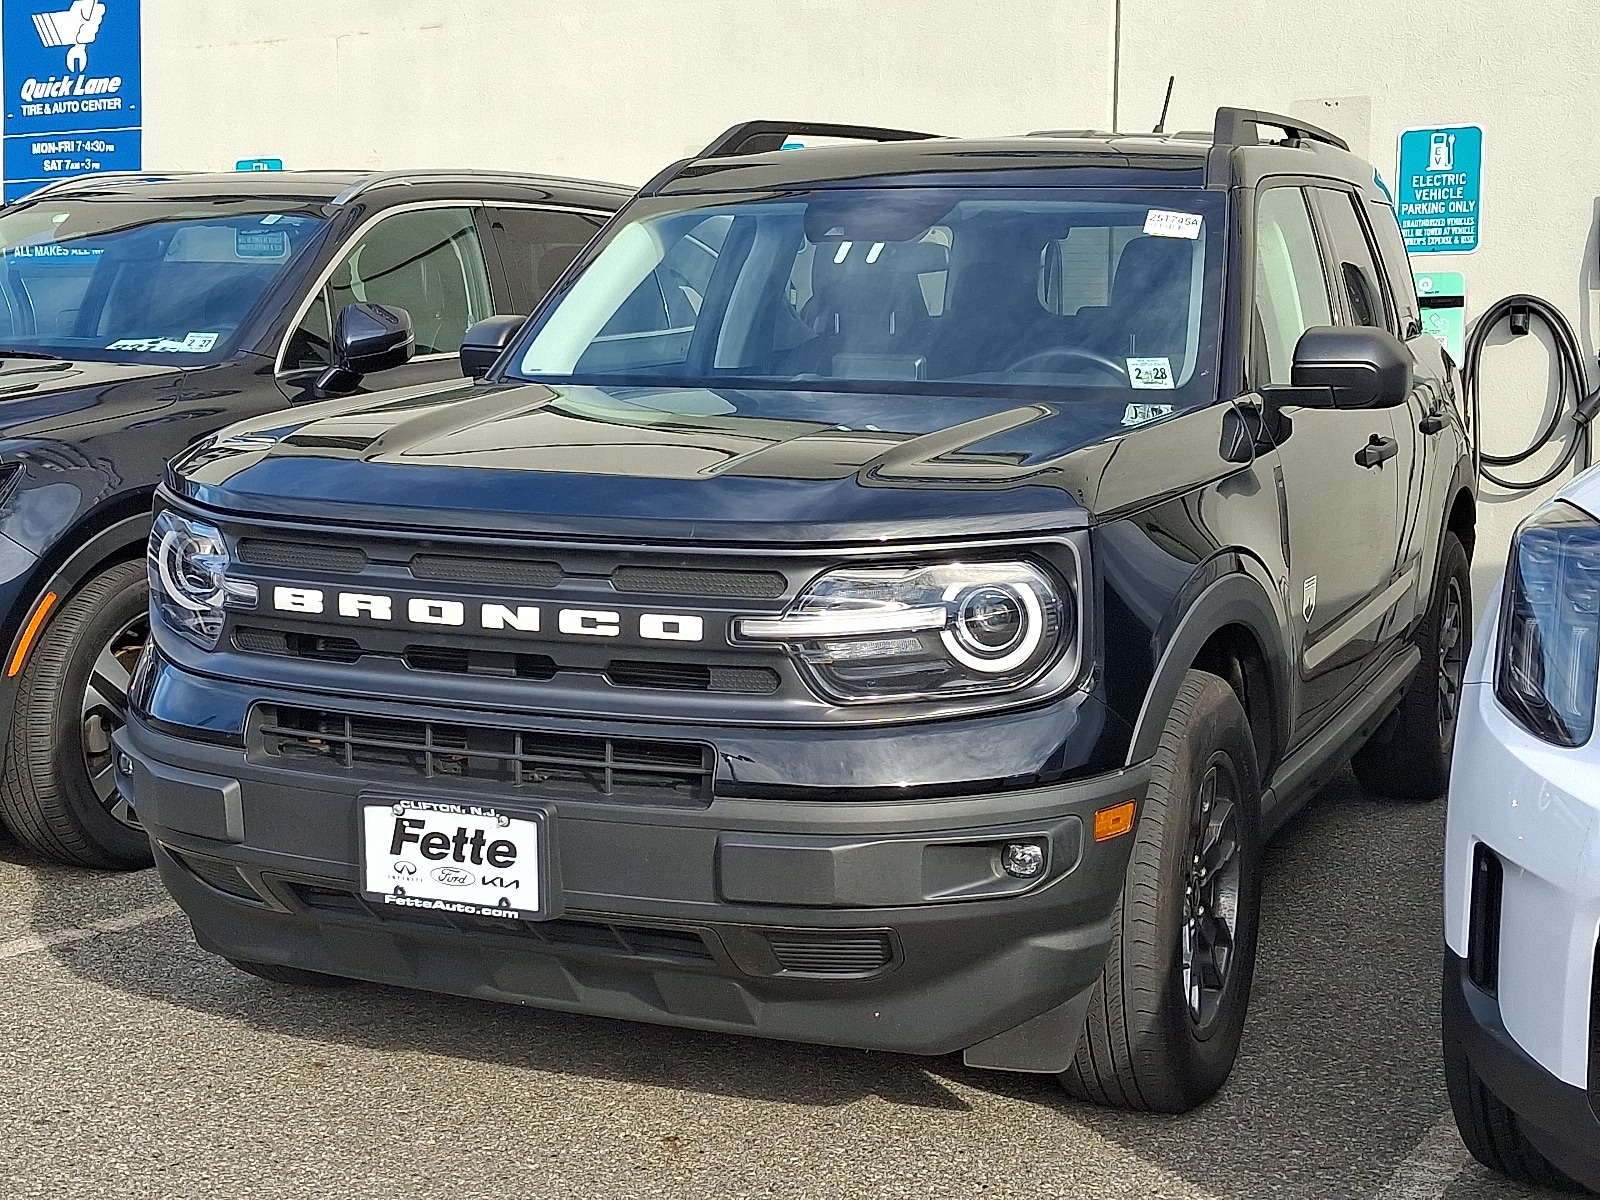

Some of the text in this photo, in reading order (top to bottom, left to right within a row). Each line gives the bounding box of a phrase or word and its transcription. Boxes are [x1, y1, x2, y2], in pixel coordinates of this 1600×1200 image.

[21, 74, 121, 102] Quick Lane
[21, 104, 43, 116] TIRE
[52, 101, 79, 115] AUTO
[81, 97, 121, 112] CENTER
[32, 140, 75, 154] MON-FRI
[43, 159, 63, 171] SAT
[1412, 172, 1467, 188] ELECTRIC
[1415, 187, 1464, 201] VEHICLE
[1401, 200, 1475, 215] PARKING ONLY
[1446, 217, 1475, 226] VEHICLES
[1424, 228, 1443, 236] TOWED
[1443, 227, 1451, 235] AT
[1451, 226, 1475, 235] VEHICLE
[14, 246, 33, 257] ALL
[34, 245, 69, 257] MAKES
[1135, 368, 1167, 379] 2 28
[273, 586, 704, 641] BRONCO
[470, 806, 500, 817] N.J.
[390, 818, 517, 868] Fette
[438, 868, 468, 884] Ford
[384, 894, 519, 919] FetteAuto.com
